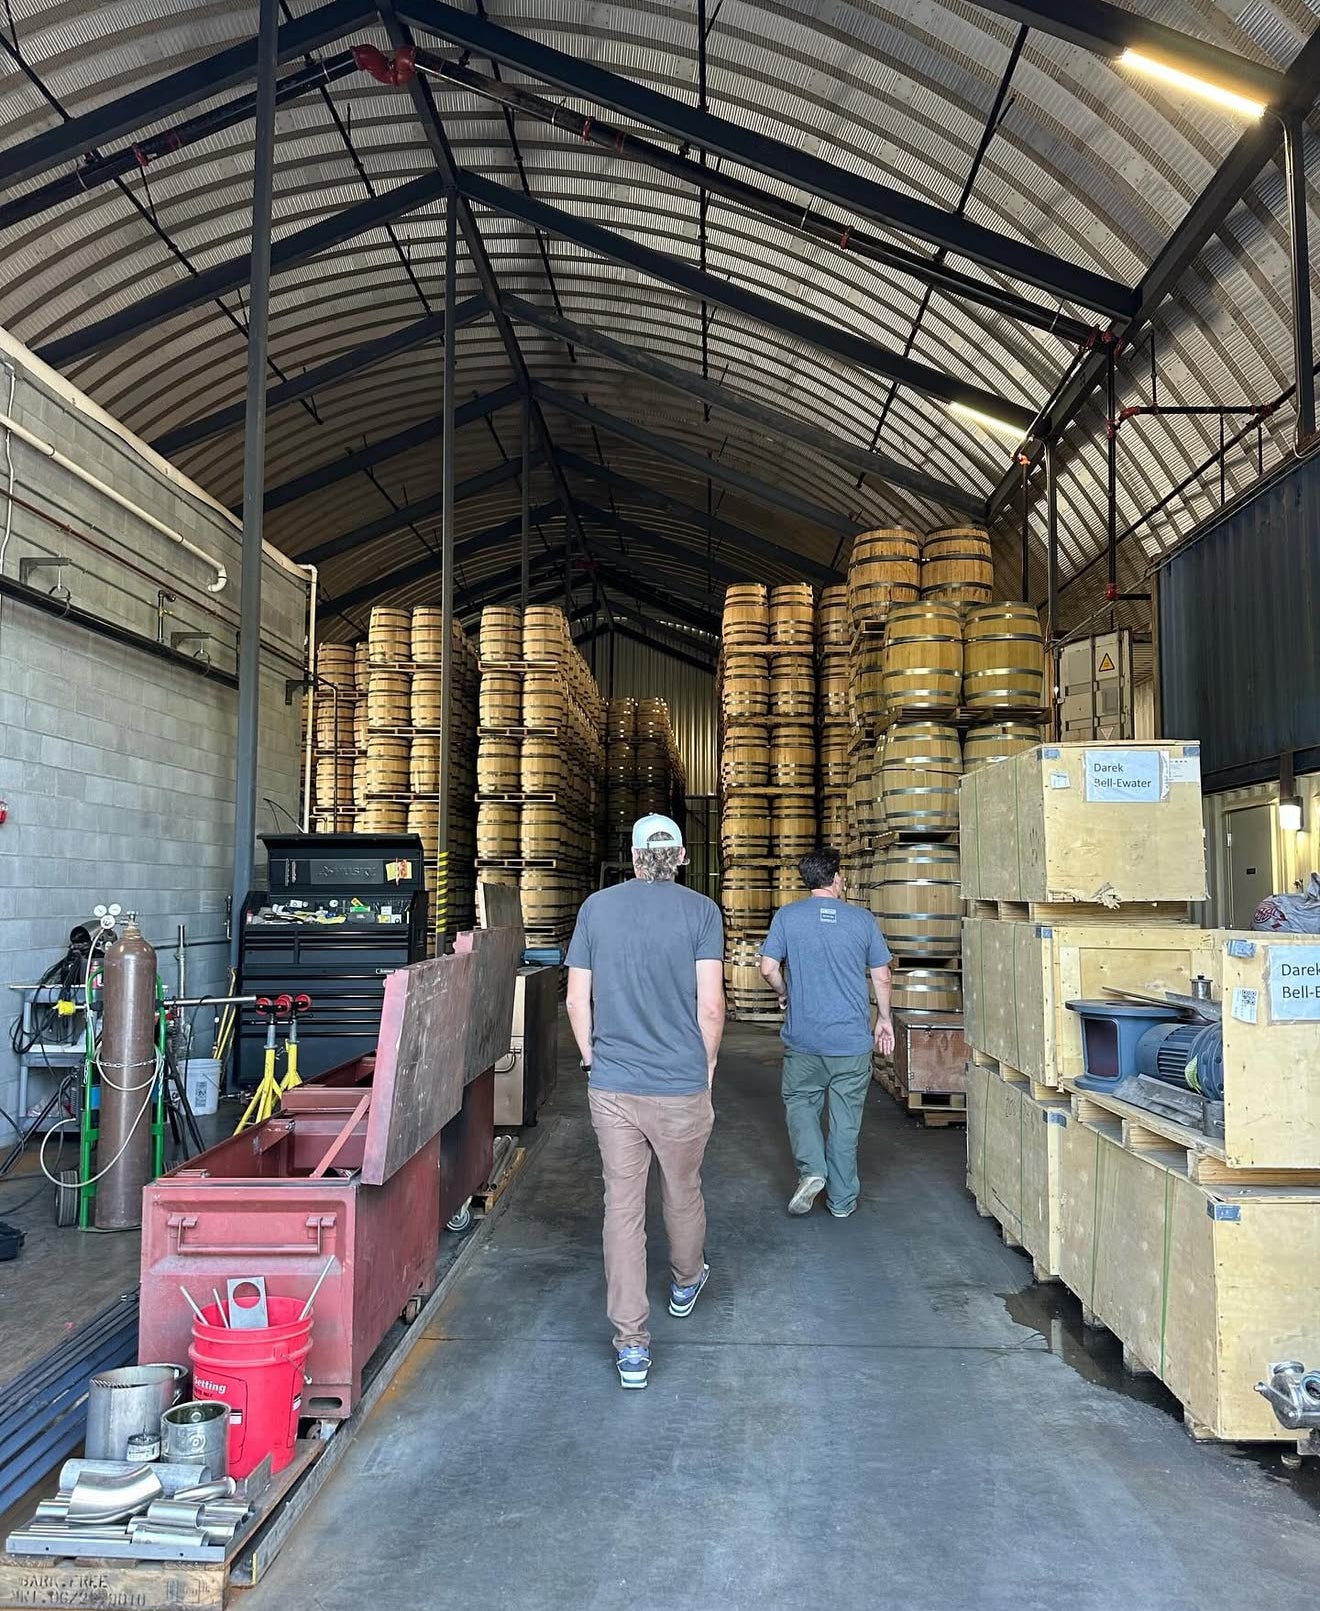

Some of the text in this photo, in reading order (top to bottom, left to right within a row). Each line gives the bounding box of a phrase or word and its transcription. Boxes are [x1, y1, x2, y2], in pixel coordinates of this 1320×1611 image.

[1093, 763, 1124, 773] Darek
[1093, 778, 1152, 788] Bell-Ewater
[1281, 962, 1320, 976] Darek
